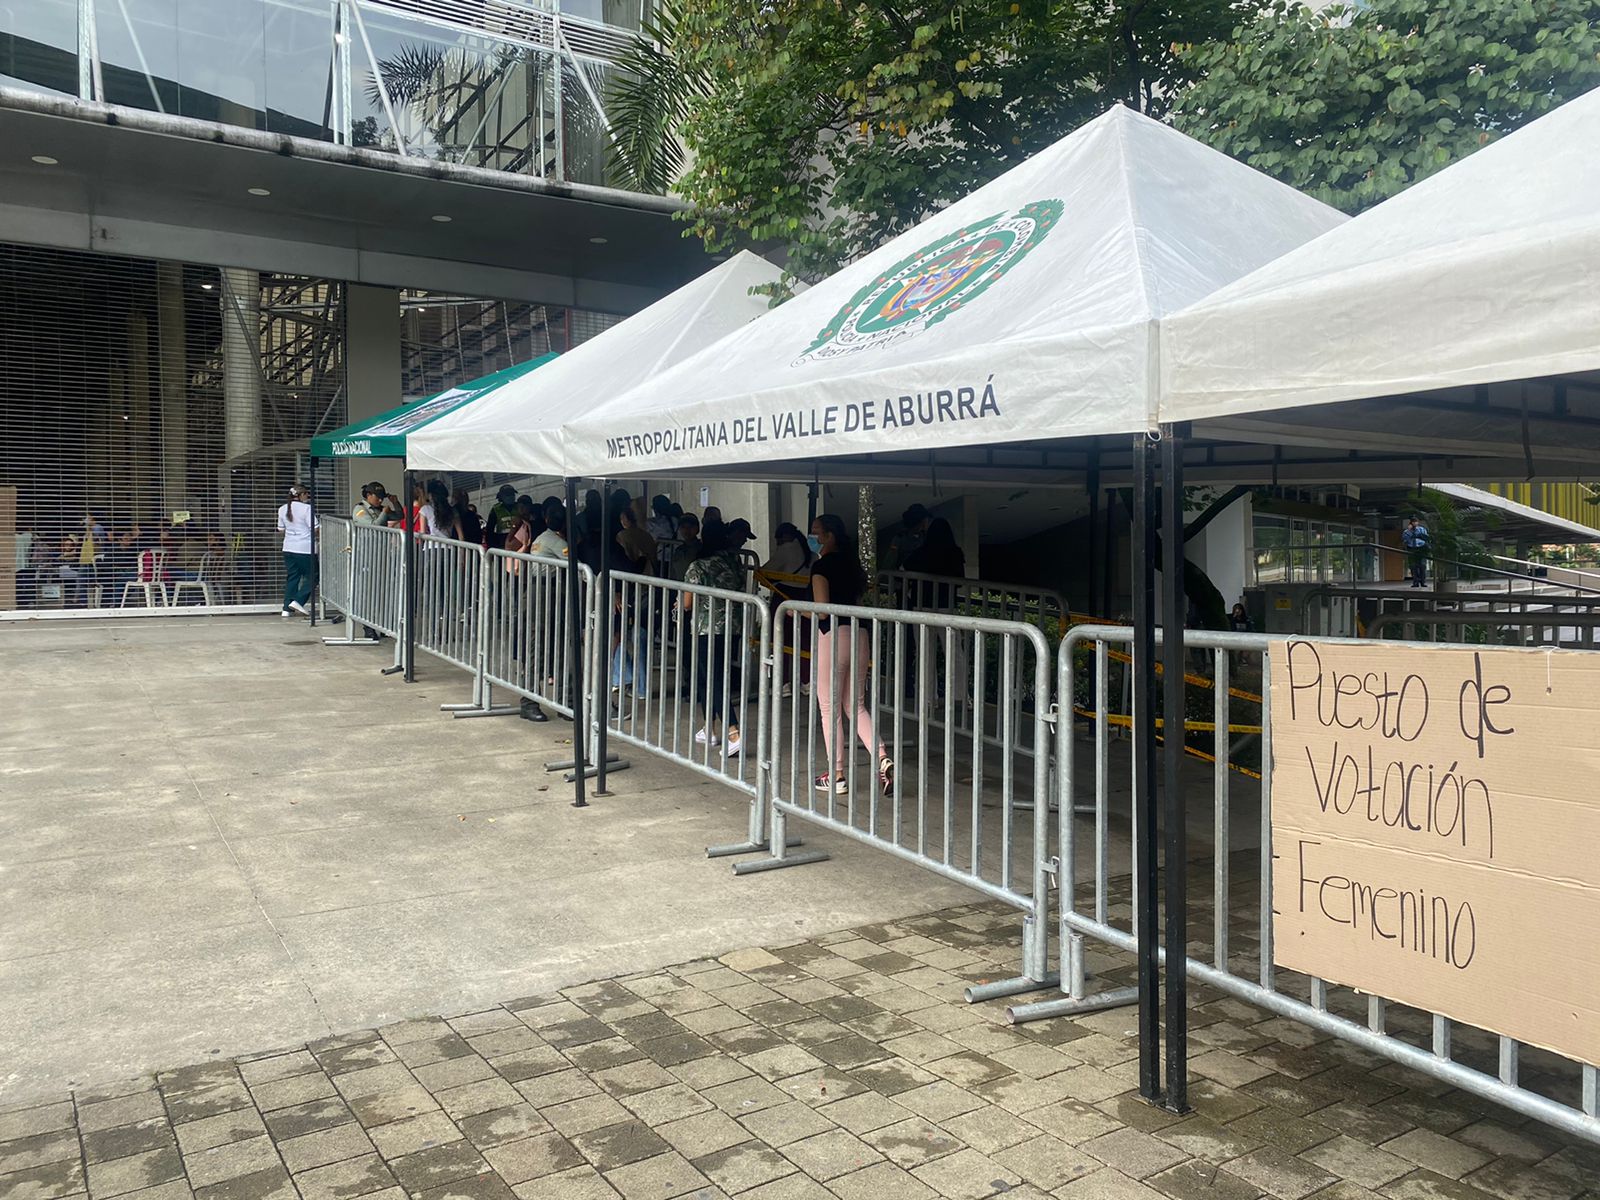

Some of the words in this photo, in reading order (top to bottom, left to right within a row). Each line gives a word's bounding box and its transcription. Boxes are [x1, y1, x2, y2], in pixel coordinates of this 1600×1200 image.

[349, 440, 372, 455] NACIONAL
[606, 421, 728, 459] METROPOLITANA
[733, 416, 767, 443] DEL
[772, 406, 838, 439] VALLE
[844, 400, 876, 433] DE
[882, 373, 1001, 430] ABURRÁ
[1287, 640, 1429, 742] Puesto
[1459, 652, 1515, 758] de
[1305, 741, 1493, 859] Votación
[1298, 840, 1475, 969] Femenino
